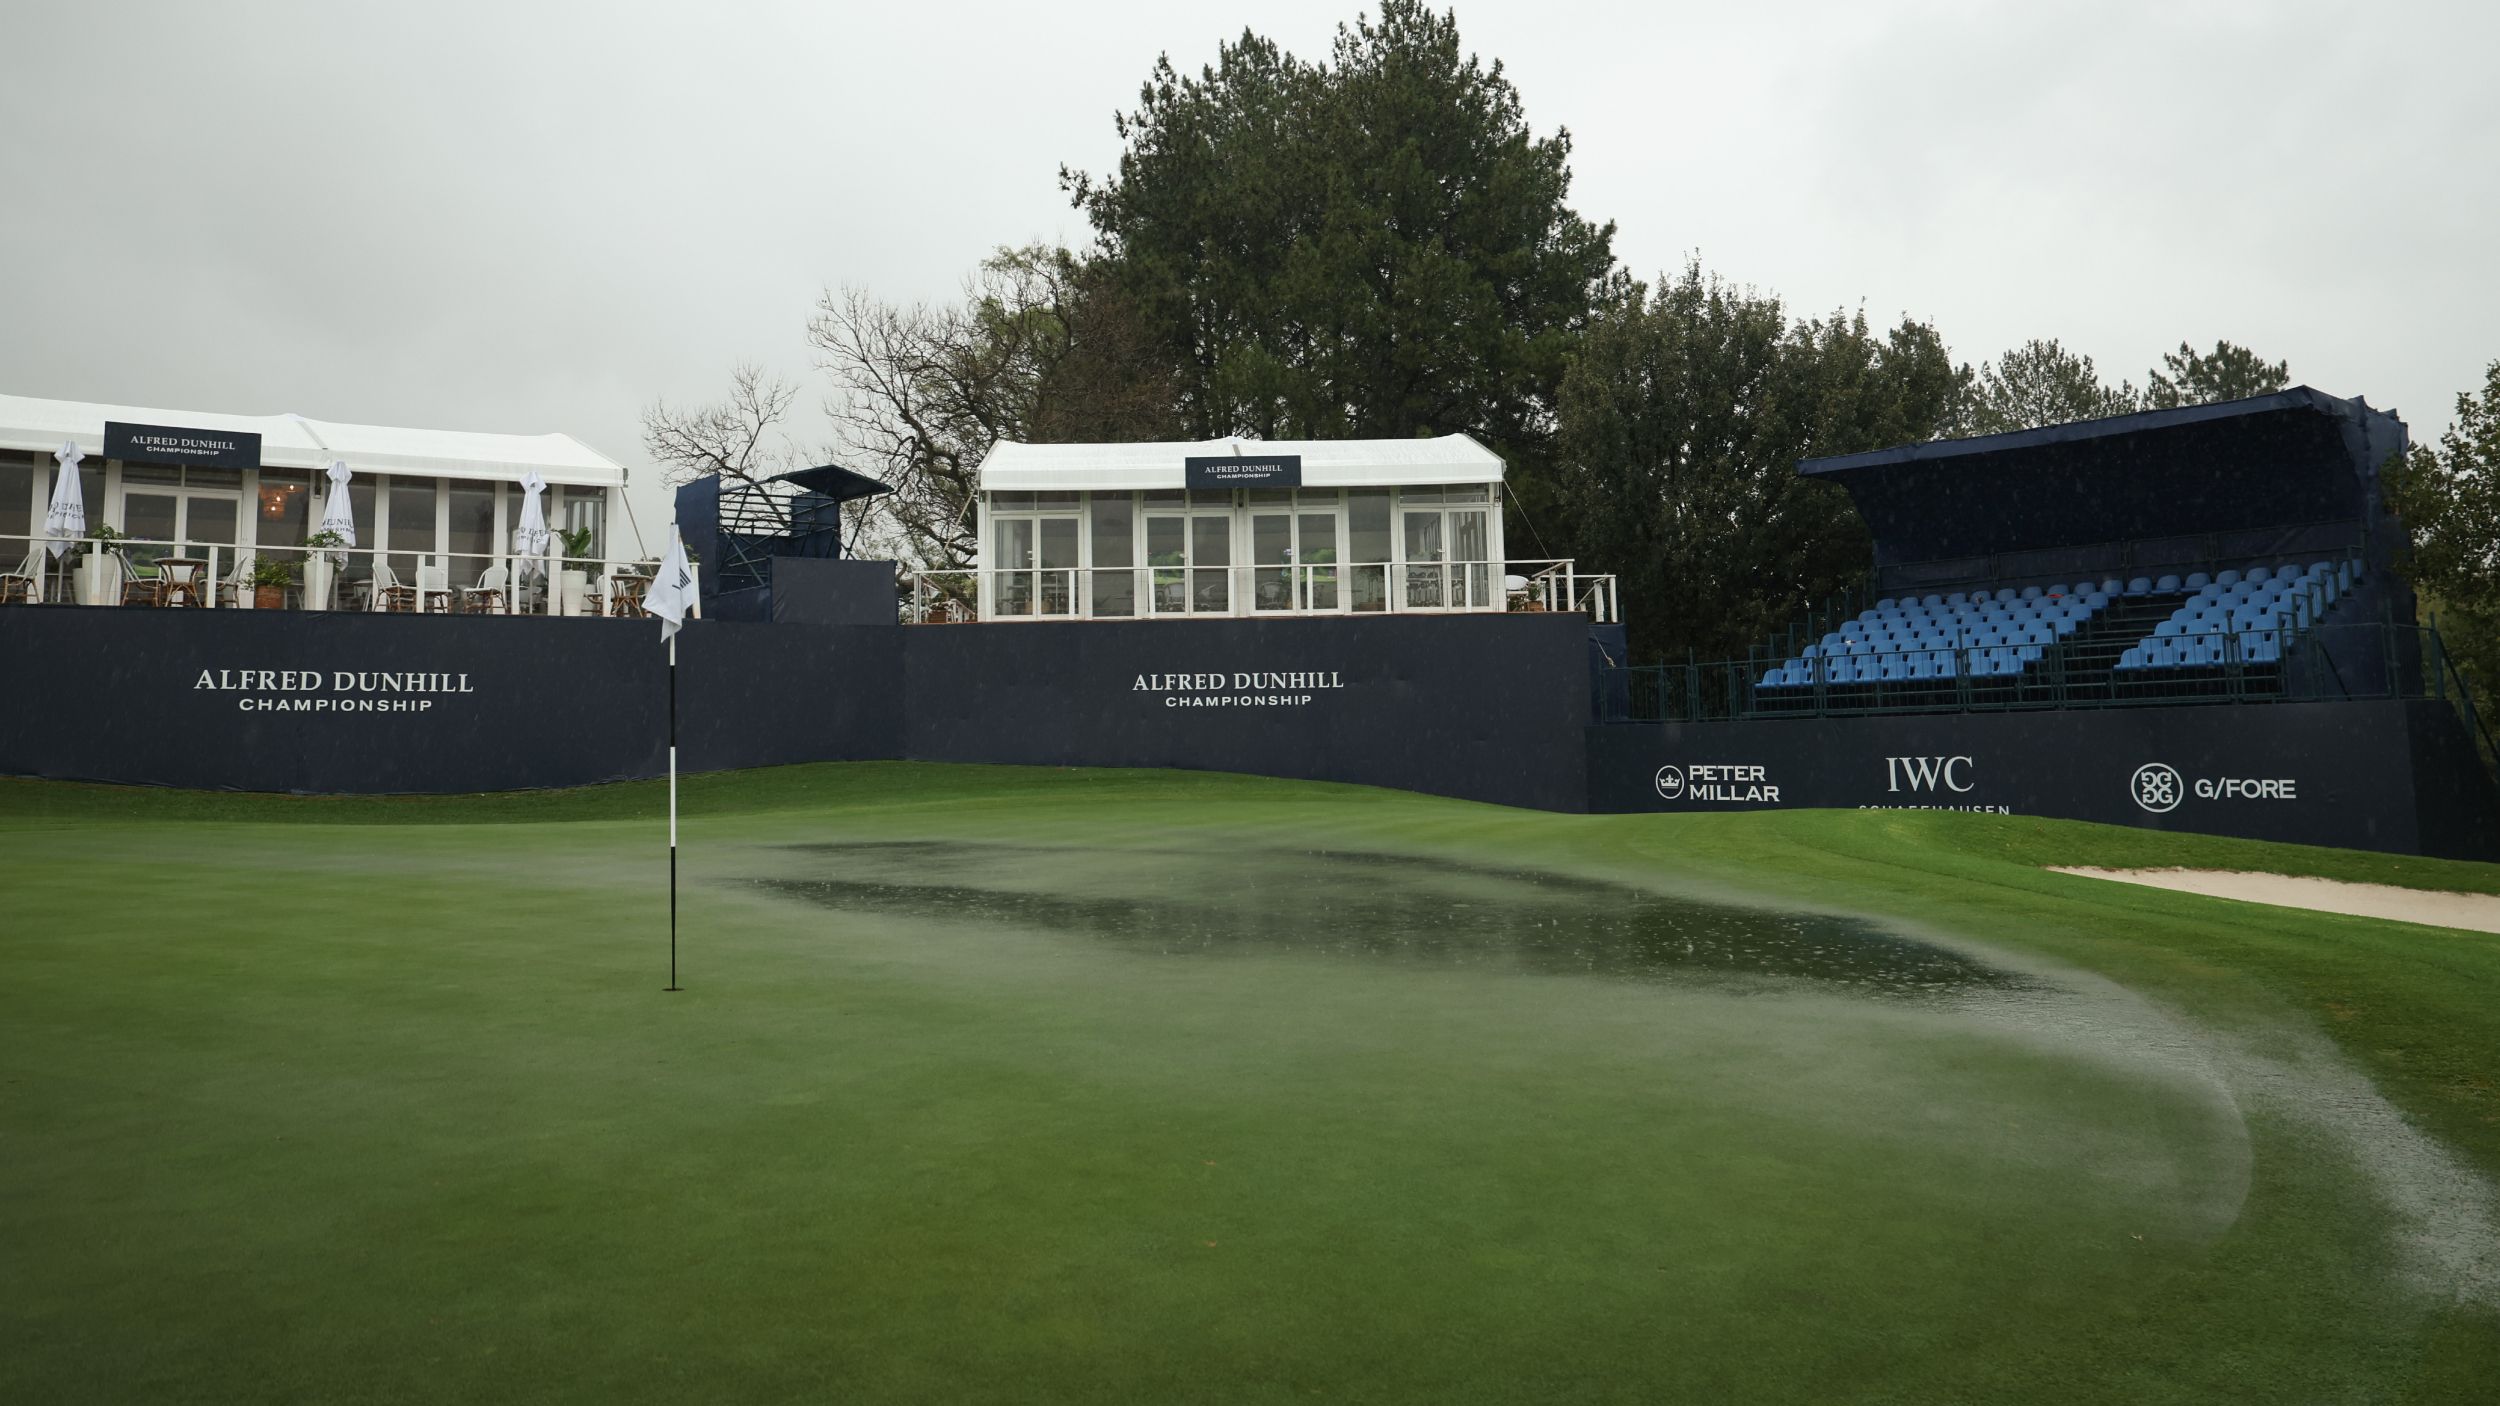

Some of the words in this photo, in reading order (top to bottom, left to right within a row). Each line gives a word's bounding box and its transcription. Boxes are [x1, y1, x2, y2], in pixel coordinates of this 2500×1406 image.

[130, 435, 178, 446] ALFRED
[181, 438, 236, 451] DUNHILL
[146, 446, 220, 456] CHAMPIONSHIP
[1204, 465, 1240, 474] ALFRED
[1242, 464, 1283, 473] DUNHILL
[193, 669, 323, 691] ALFRED
[333, 671, 475, 693] DUNHILL
[1132, 673, 1226, 691] ALFRED
[1233, 671, 1345, 690] DUNHILL
[239, 698, 433, 712] CHAMPIONSHIP
[1165, 695, 1312, 708] CHAMPIONSHIP
[1688, 764, 1766, 782] PETER
[1885, 755, 1975, 793] IWC
[1689, 784, 1780, 802] MILLAR
[2194, 777, 2297, 800] G/FORE
